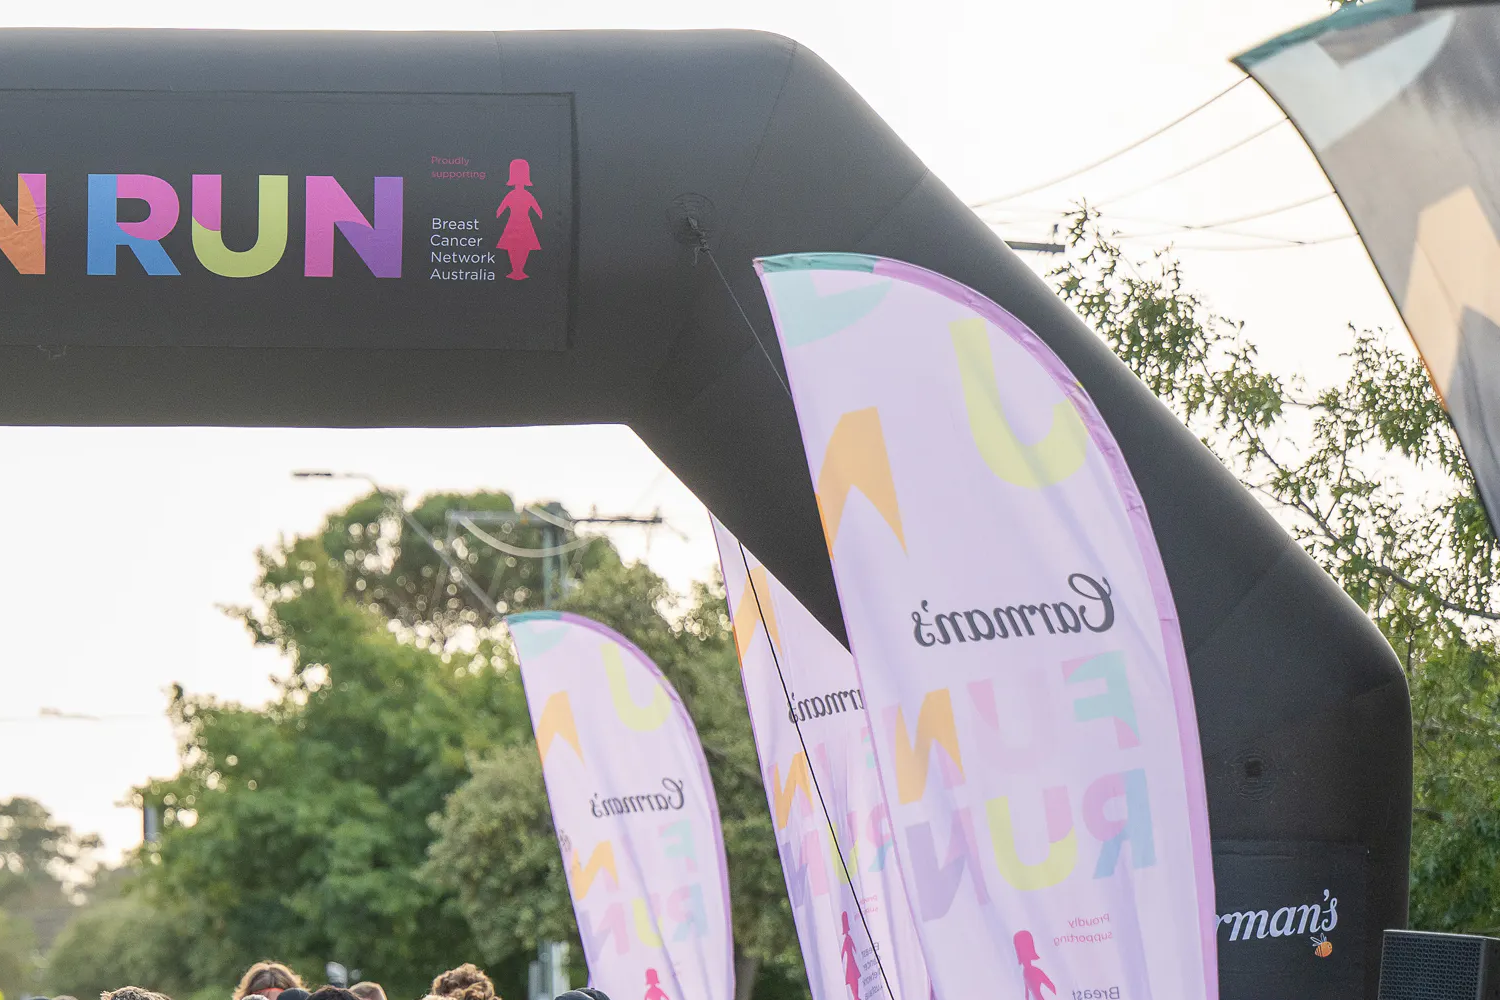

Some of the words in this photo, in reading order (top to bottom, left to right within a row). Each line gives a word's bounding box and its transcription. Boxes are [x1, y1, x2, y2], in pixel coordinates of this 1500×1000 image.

[430, 154, 470, 167] Proudly
[430, 168, 487, 180] supporting
[86, 173, 404, 278] RUN
[431, 217, 480, 231] Breast
[430, 233, 484, 248] Cancer
[430, 250, 496, 265] Network
[429, 267, 496, 281] Australia
[1215, 888, 1338, 942] rman's
